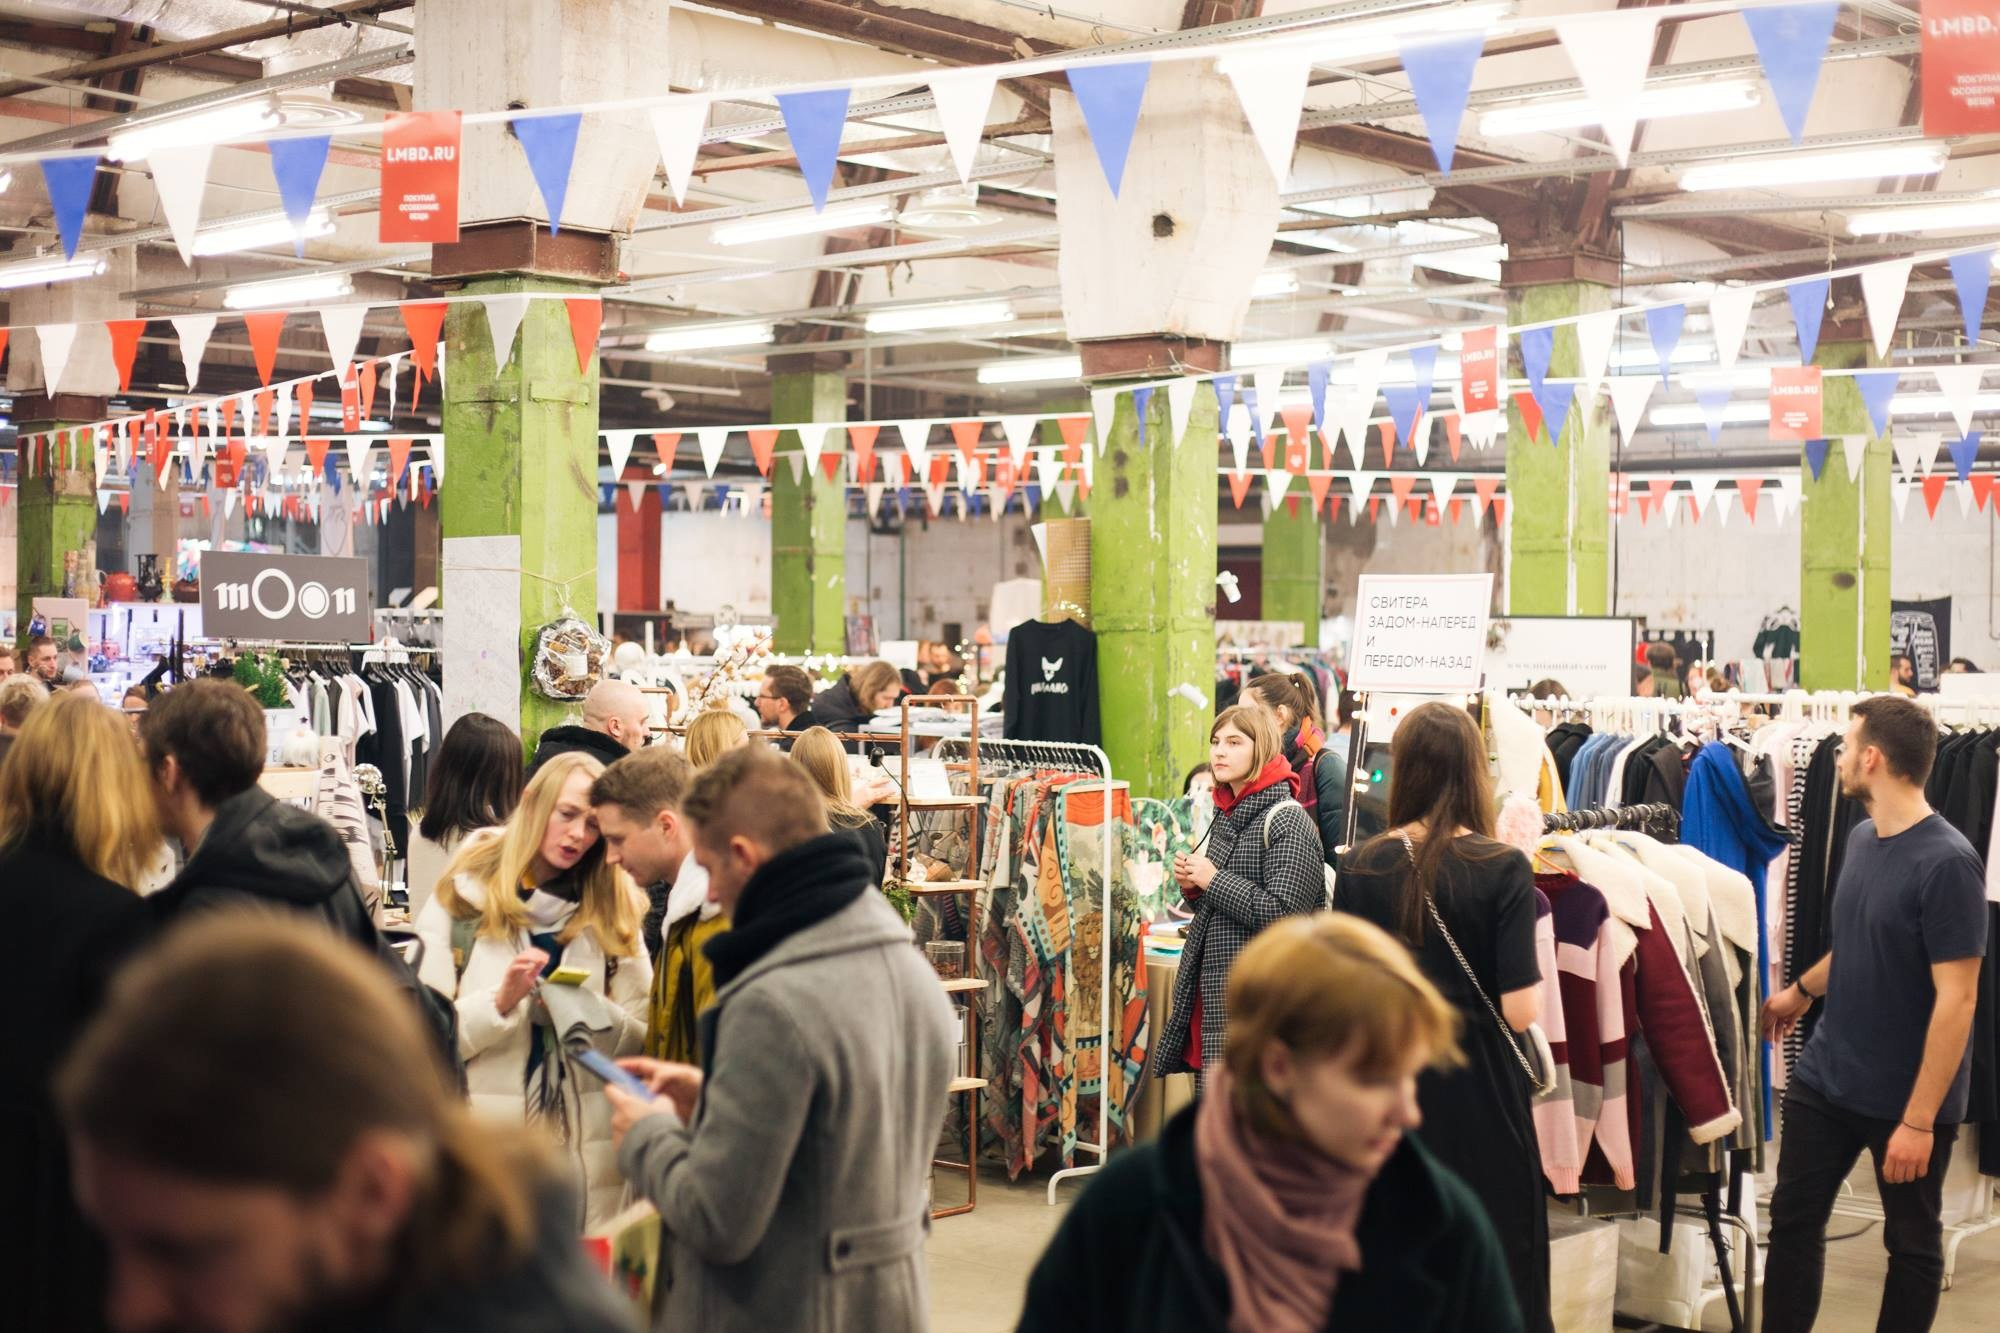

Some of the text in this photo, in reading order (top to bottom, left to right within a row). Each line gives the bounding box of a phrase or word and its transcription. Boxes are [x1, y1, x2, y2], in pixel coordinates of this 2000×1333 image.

[1929, 14, 2000, 36] LMBD.
[1957, 72, 2000, 84] ПОКУПА
[387, 145, 455, 163] LMBD.RU
[1772, 384, 1819, 397] LMBD.RU
[1370, 596, 1429, 609] СВИТЕРА
[1368, 615, 1477, 629] ЗАДОМ-НАПЕРЕД
[1366, 635, 1375, 647] И
[1363, 654, 1473, 669] ПЕРЕДОМ-НАЗАД
